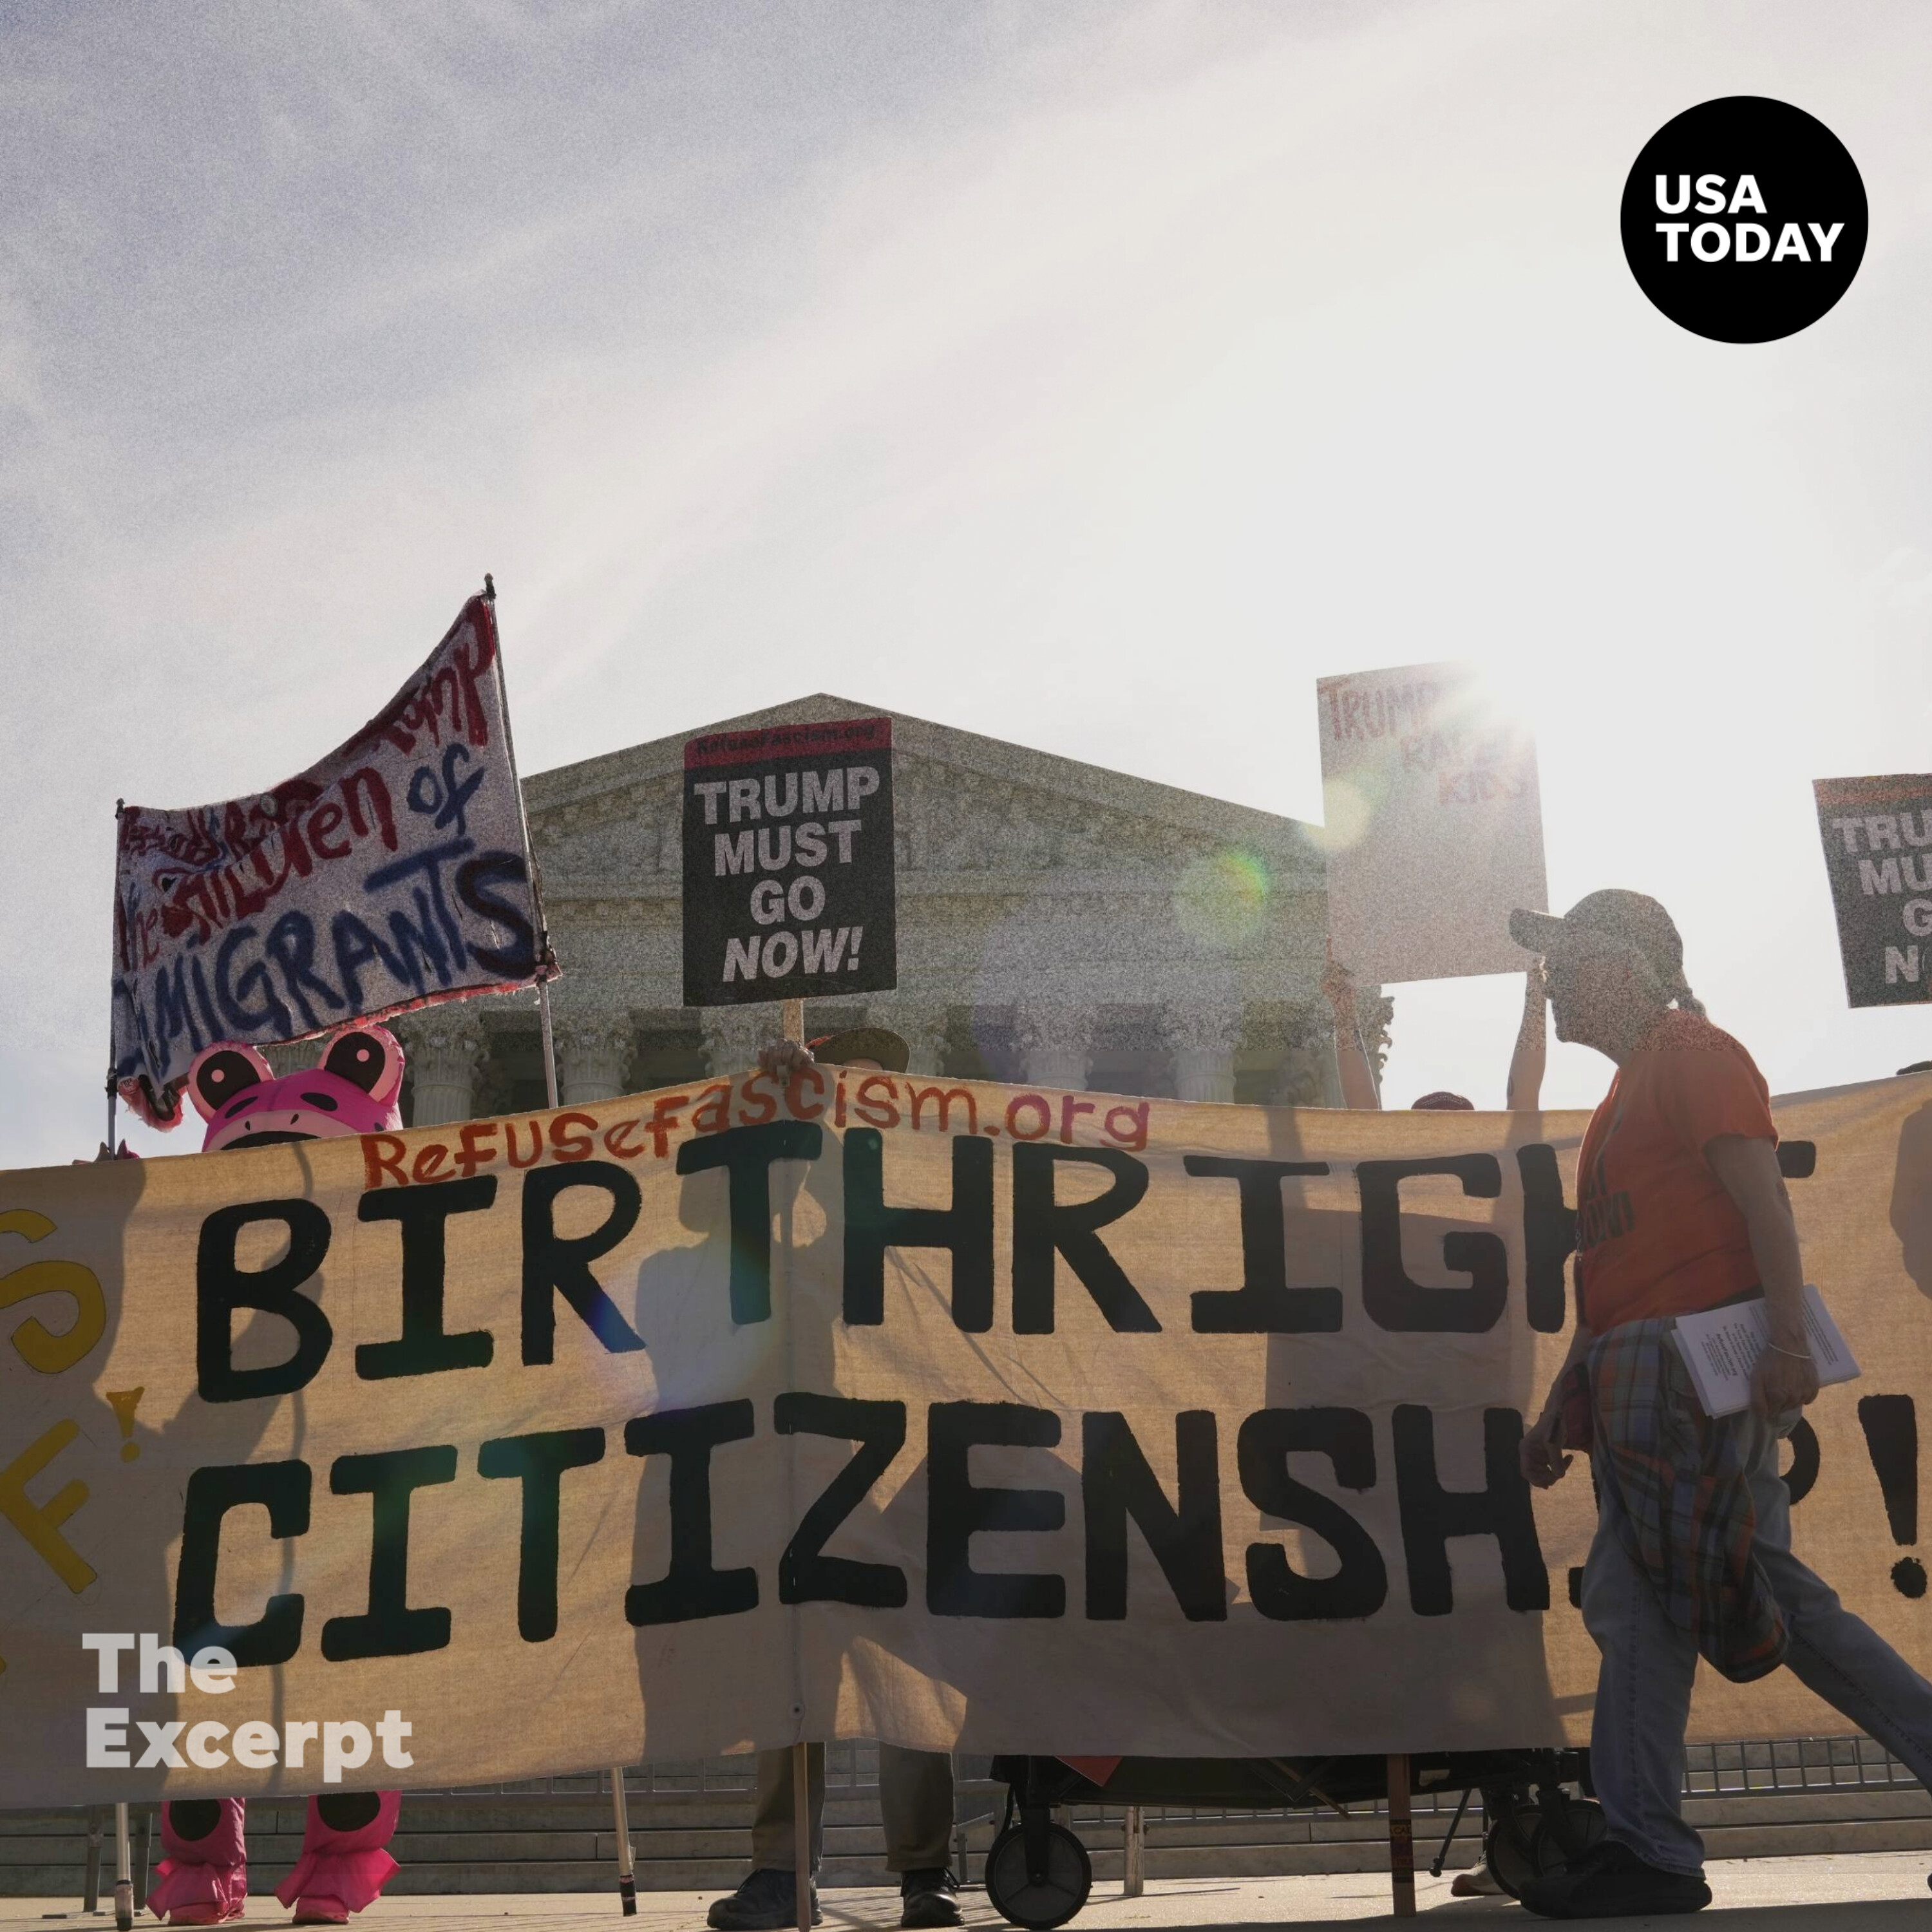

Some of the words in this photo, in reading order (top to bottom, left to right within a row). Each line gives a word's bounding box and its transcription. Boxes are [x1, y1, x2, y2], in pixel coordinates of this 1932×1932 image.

[694, 766, 880, 825] TRUMP
[714, 819, 862, 876] MUST
[1832, 809, 1932, 853] TRU
[750, 875, 826, 925] GO
[1858, 853, 1932, 895] MU
[722, 926, 864, 983] NOW!
[1885, 944, 1932, 984] N
[196, 1119, 1816, 1403] BIRTHRIGH
[172, 1392, 1927, 1669] CITIZENSH!
